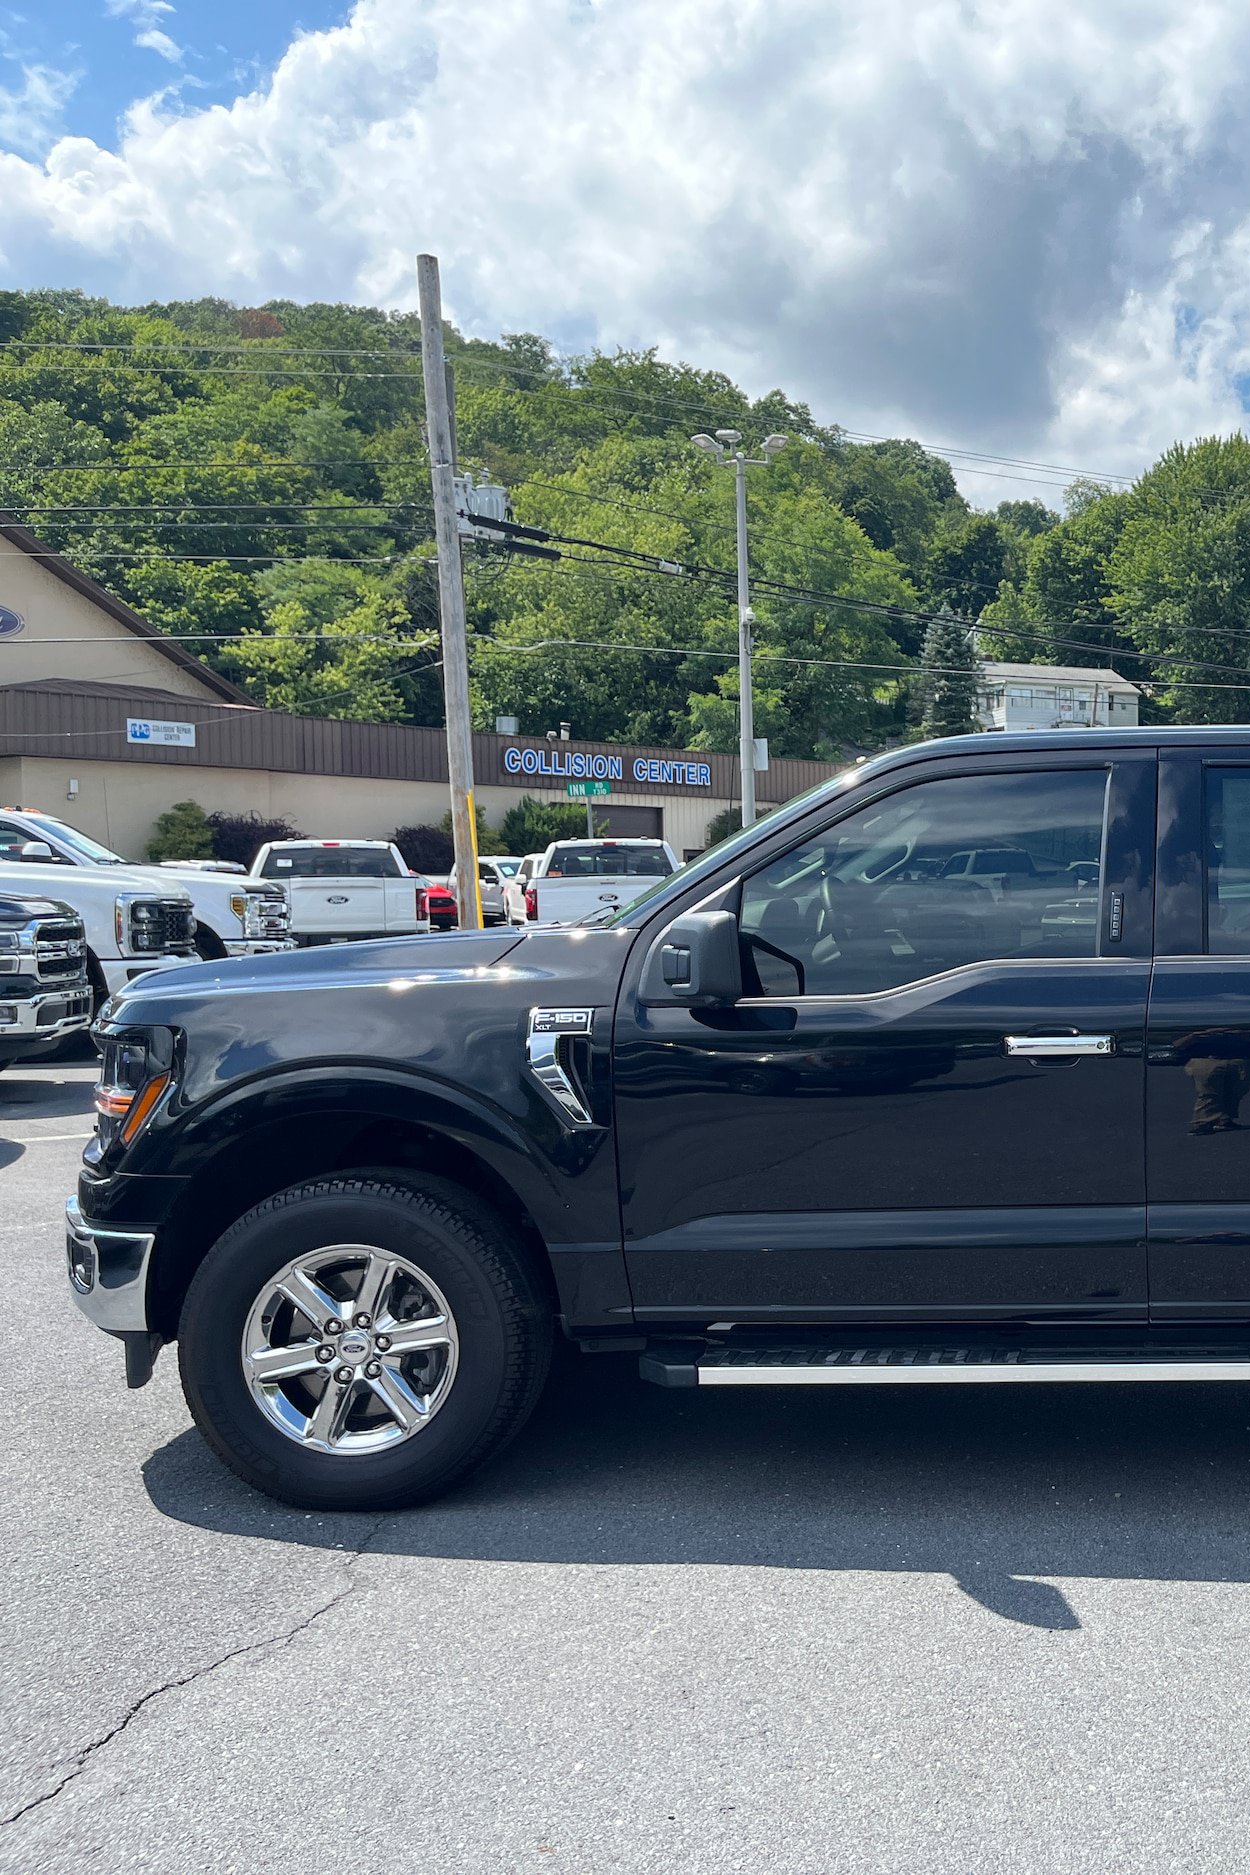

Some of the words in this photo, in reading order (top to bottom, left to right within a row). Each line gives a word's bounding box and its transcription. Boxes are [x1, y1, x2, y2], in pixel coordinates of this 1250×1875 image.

[131, 724, 150, 738] PPG
[504, 747, 623, 780] COLLISION
[633, 757, 711, 786] CENTER
[569, 784, 586, 796] INN
